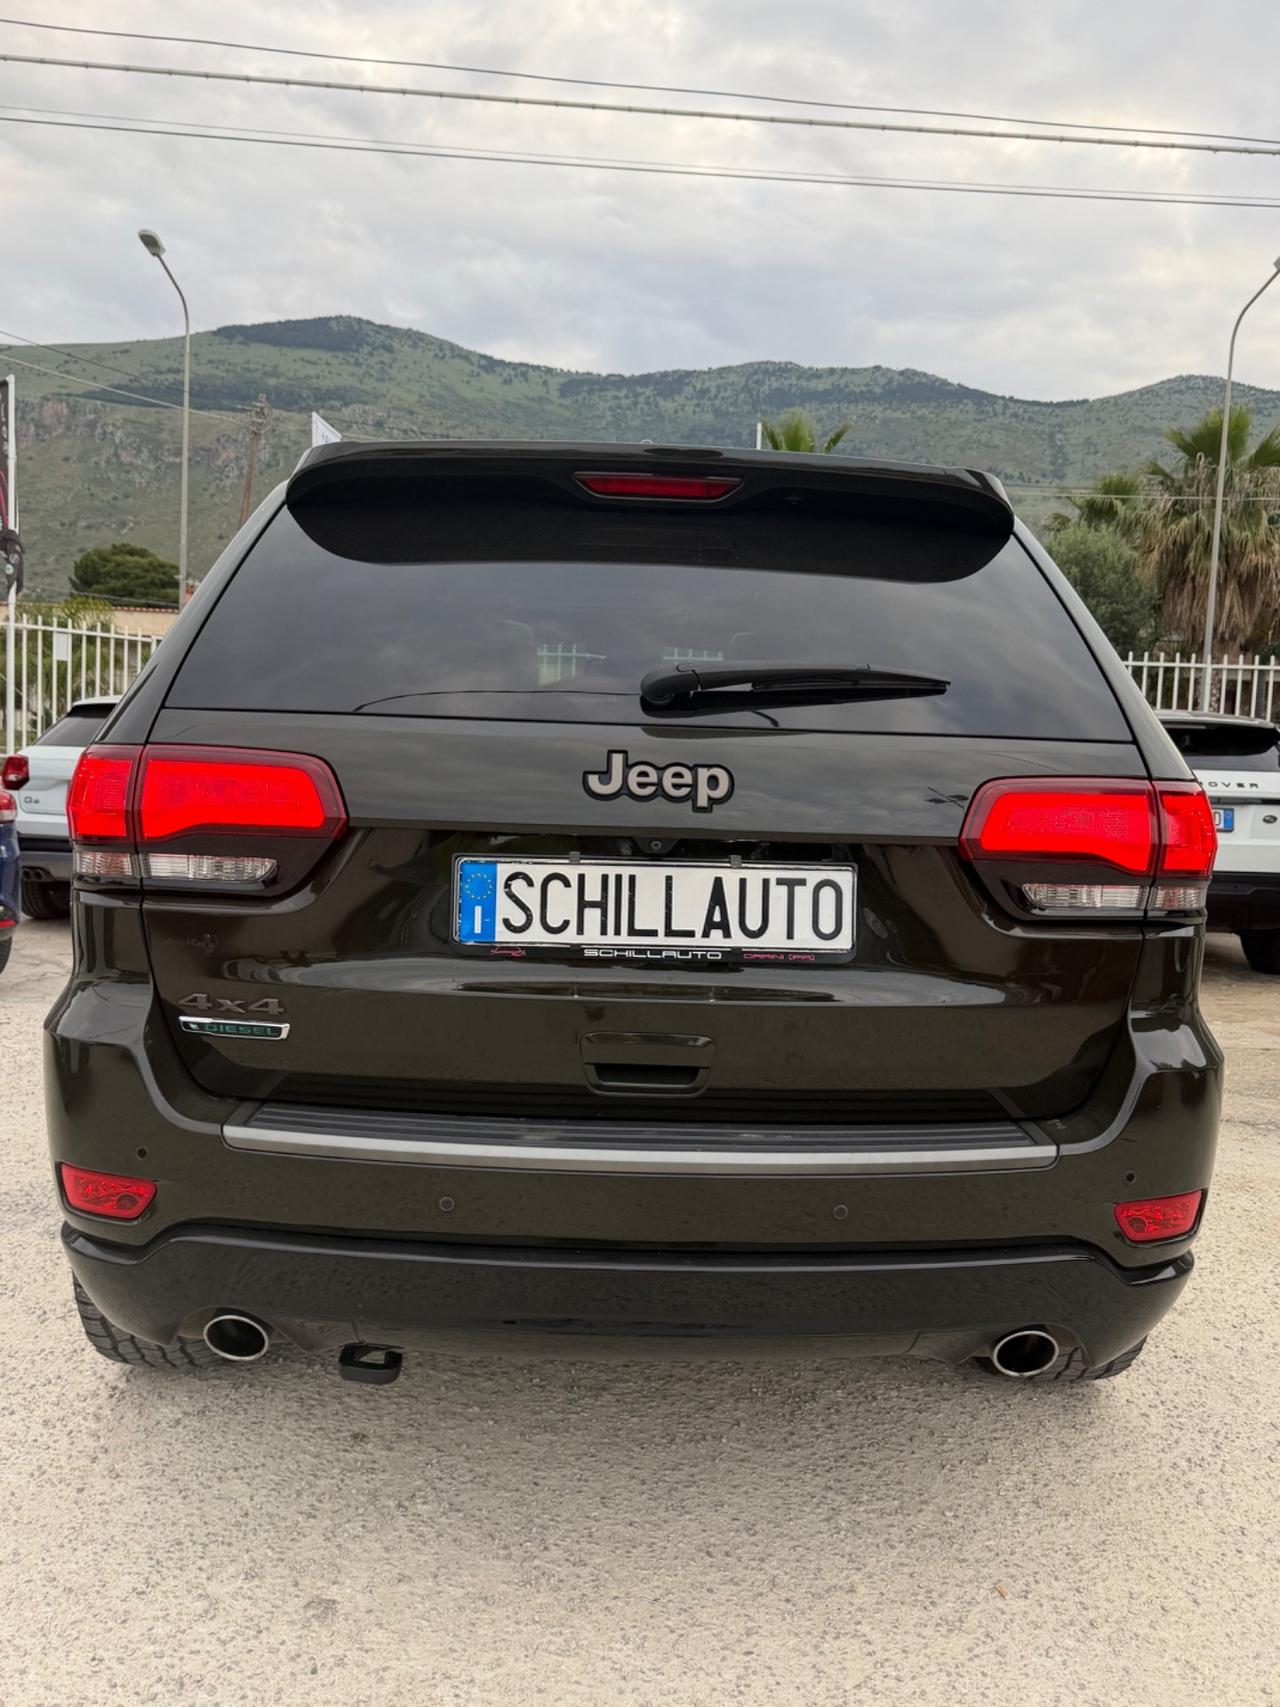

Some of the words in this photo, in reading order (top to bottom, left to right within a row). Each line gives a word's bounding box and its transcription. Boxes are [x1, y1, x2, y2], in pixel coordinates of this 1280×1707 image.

[583, 750, 734, 813] Jeep
[1199, 781, 1259, 789] OVER
[502, 872, 843, 940] SCHILLAUTO
[583, 948, 722, 960] SCHILLAUTO
[205, 1023, 277, 1036] DIESEL
